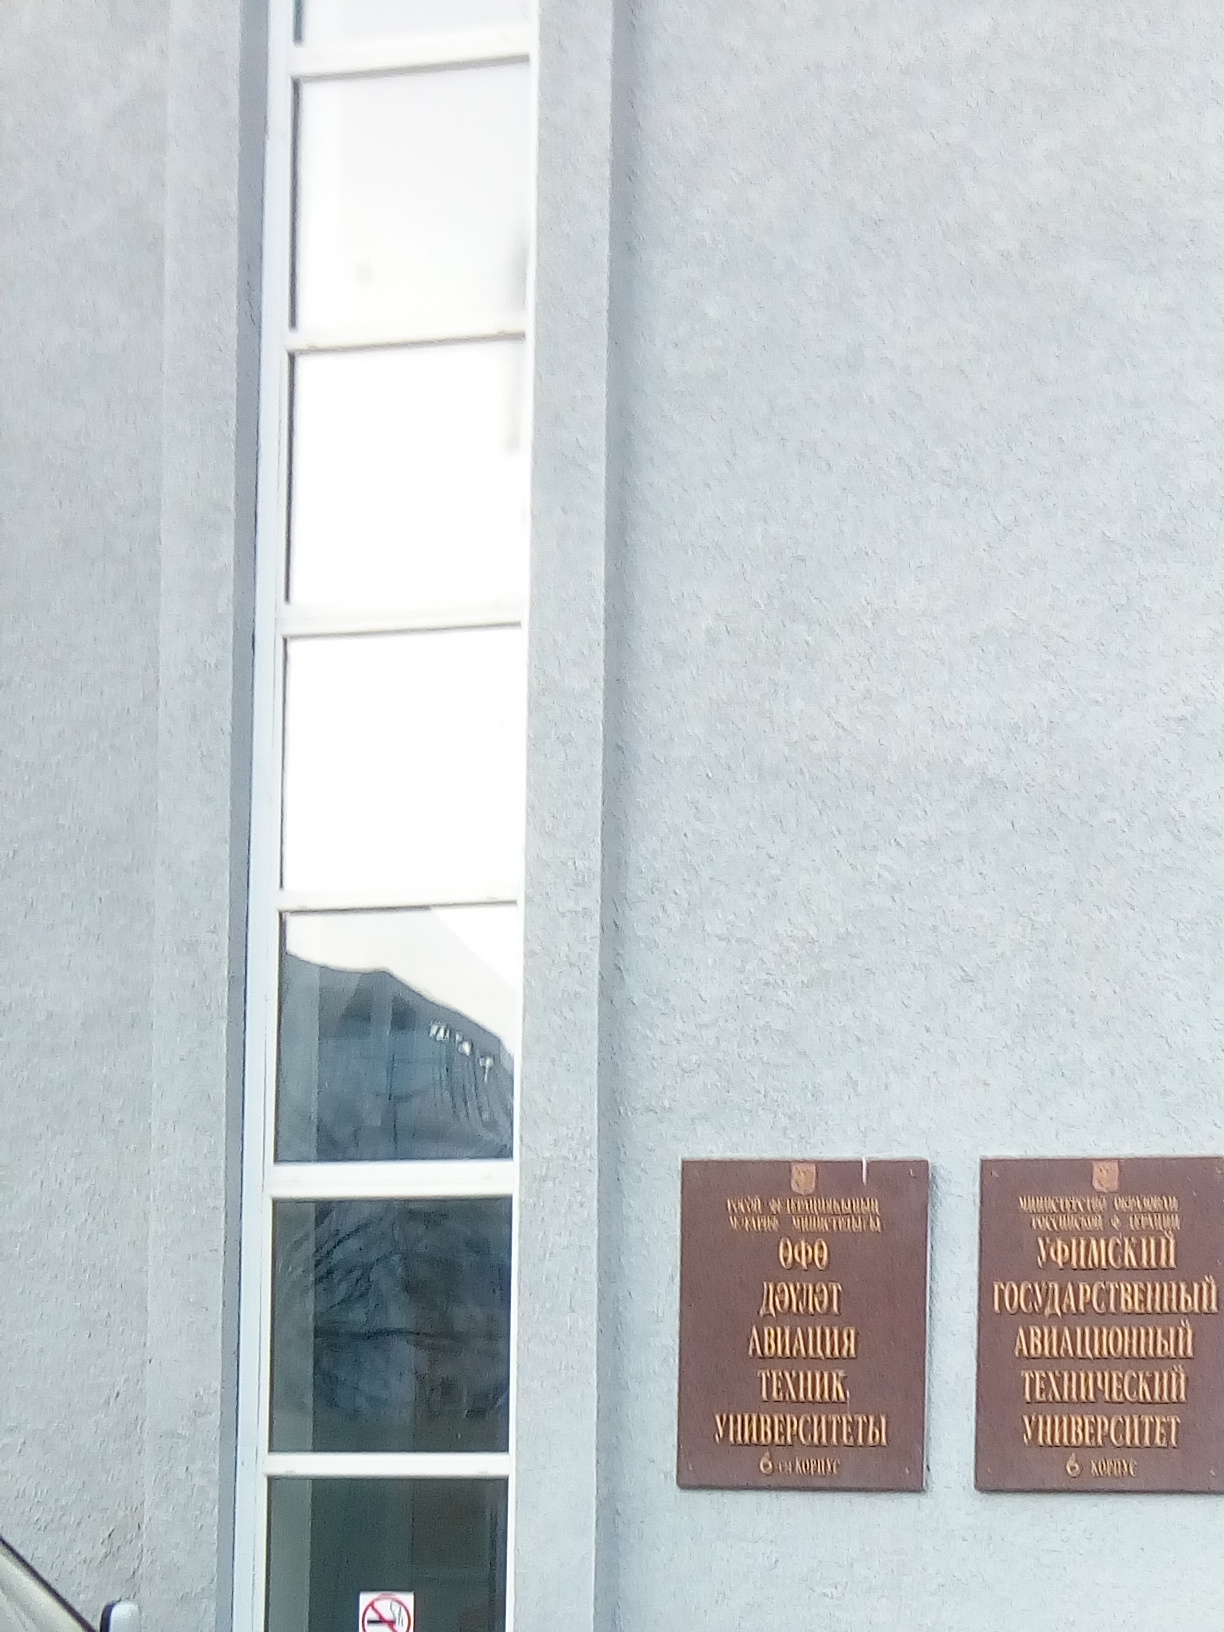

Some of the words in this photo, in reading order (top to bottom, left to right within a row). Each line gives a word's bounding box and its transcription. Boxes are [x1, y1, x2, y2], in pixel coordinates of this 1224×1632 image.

[1037, 1231, 1177, 1269] УФИМСКИЙ
[993, 1275, 1219, 1317] ГОСУДАРСТВЕННЫЙ
[749, 1325, 857, 1359] АВИАЦИЯ
[1015, 1320, 1194, 1360] АВИАЦИОННЫЙ
[757, 1369, 847, 1403] ТЕХНИК
[1021, 1365, 1187, 1403] ТЕХНИЧЕСКИЙ
[715, 1413, 887, 1446] УНИВЕРСИТЕТЫ
[1023, 1414, 1180, 1448] УНИВЕРСИТЕТ
[1066, 1452, 1081, 1478] 6
